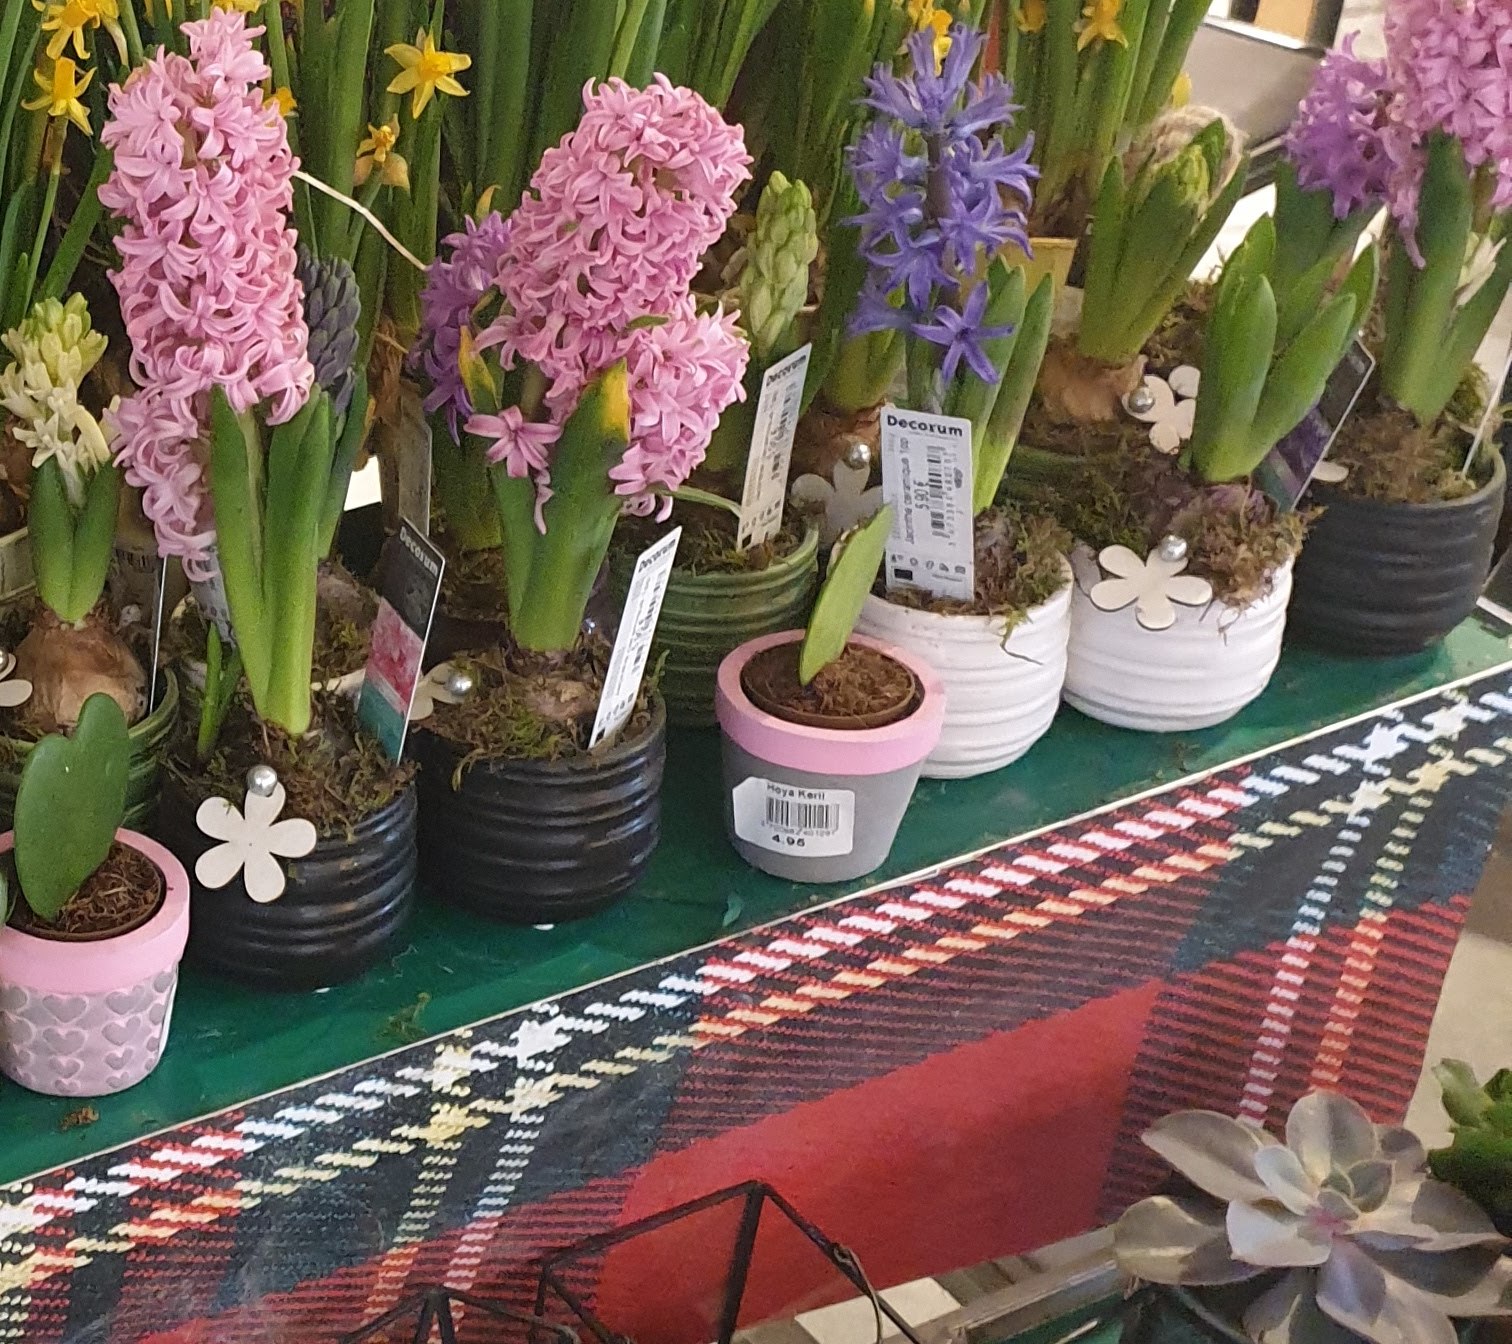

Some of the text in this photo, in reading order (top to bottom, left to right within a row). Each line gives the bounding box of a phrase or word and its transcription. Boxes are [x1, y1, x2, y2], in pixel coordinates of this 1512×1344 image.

[887, 414, 964, 438] Decorum
[399, 526, 438, 577] Decorum
[766, 782, 795, 798] Hoya
